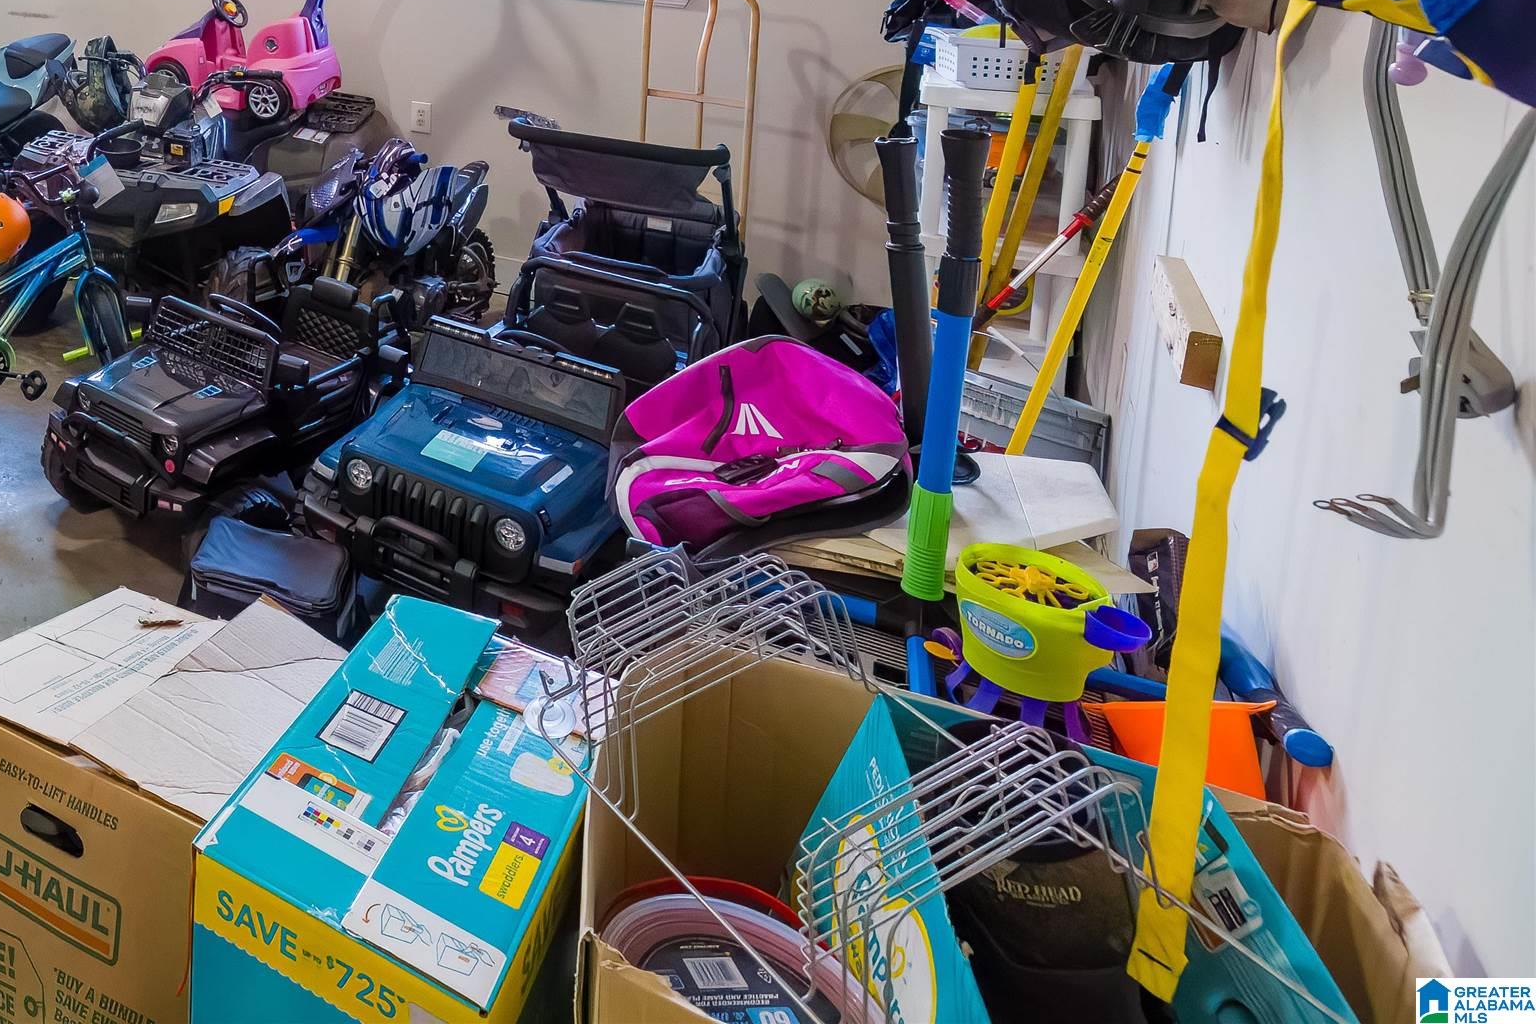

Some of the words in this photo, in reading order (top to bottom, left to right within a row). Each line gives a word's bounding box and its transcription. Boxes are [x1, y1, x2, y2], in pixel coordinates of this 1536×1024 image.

[966, 610, 1025, 650] TORNADO
[476, 738, 493, 757] use
[0, 758, 66, 803] EASY-TO-LIFT
[67, 794, 119, 830] HANDLES
[427, 803, 504, 887] Pampers
[519, 834, 536, 846] 4
[497, 854, 524, 899] swaddlers
[216, 889, 298, 962] SAVE
[55, 989, 89, 1020] SAVE
[85, 986, 96, 1004] A
